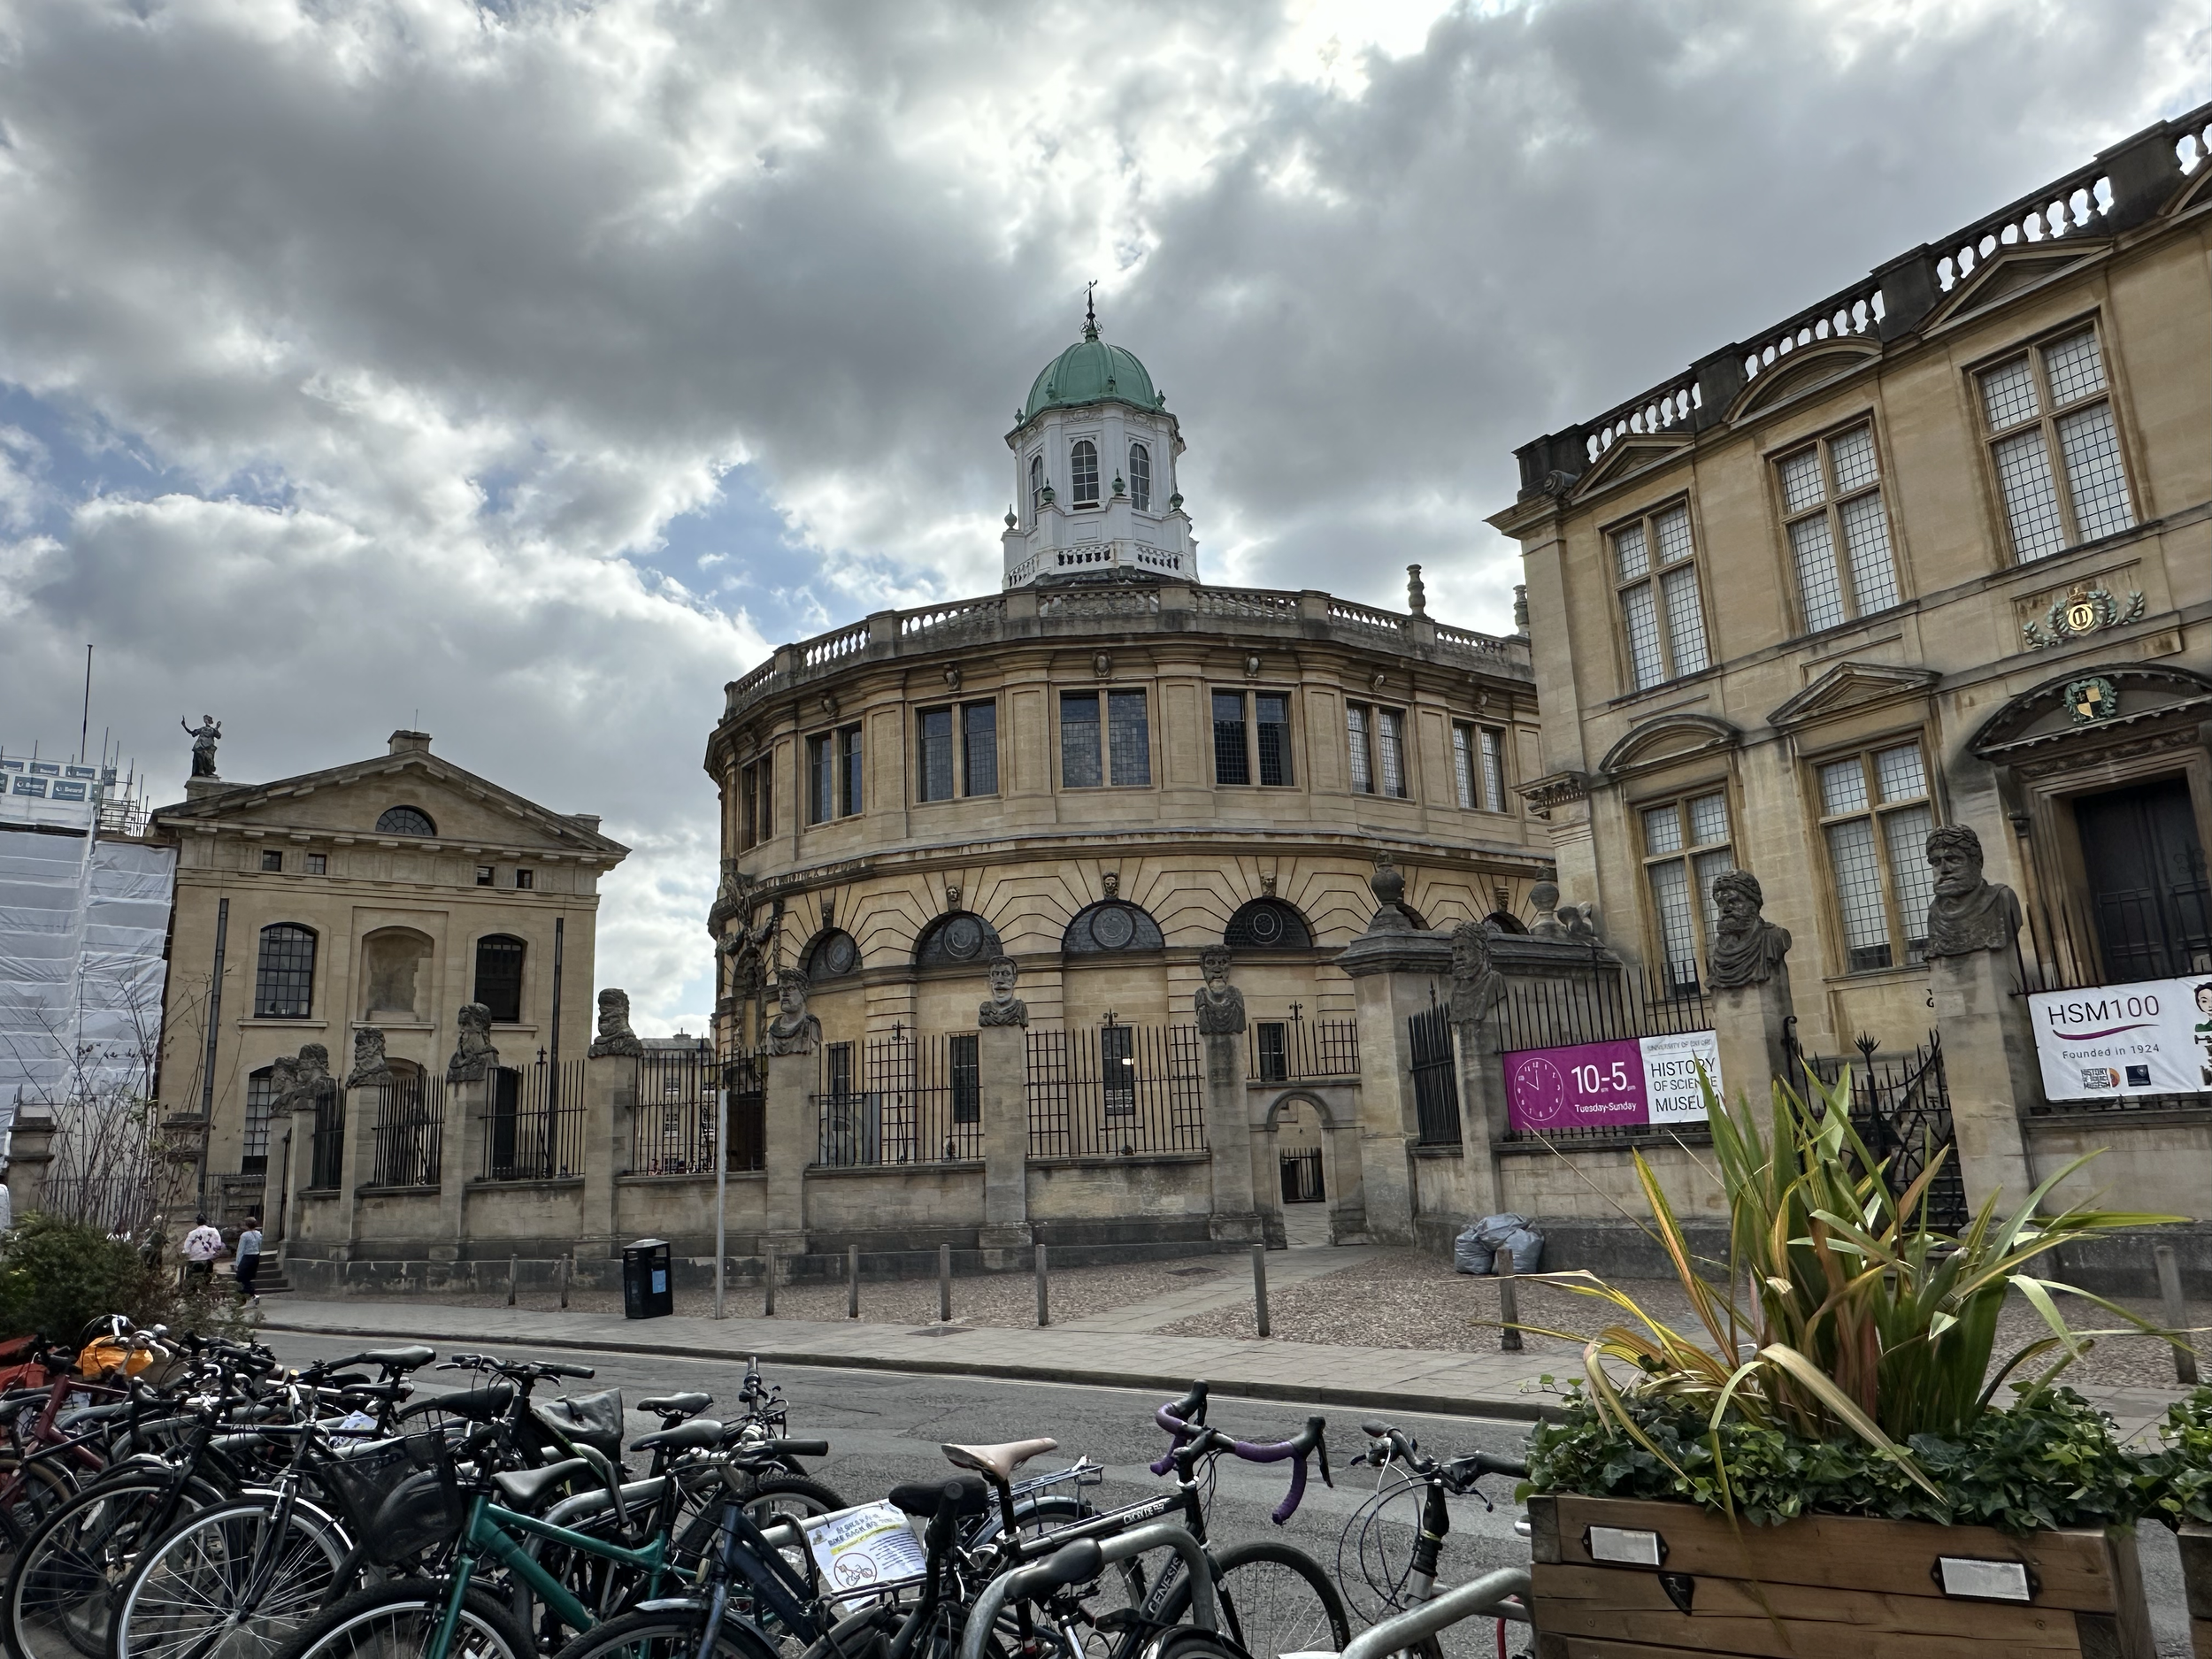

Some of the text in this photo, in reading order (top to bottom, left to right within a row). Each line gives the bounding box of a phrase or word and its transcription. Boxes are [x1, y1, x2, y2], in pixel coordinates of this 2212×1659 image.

[2047, 995, 2160, 1025] HSM100
[2062, 1043, 2160, 1059] Founded in 1924
[1654, 1076, 1717, 1092] OF SCIENE
[1148, 1557, 1181, 1614] GENESIS
